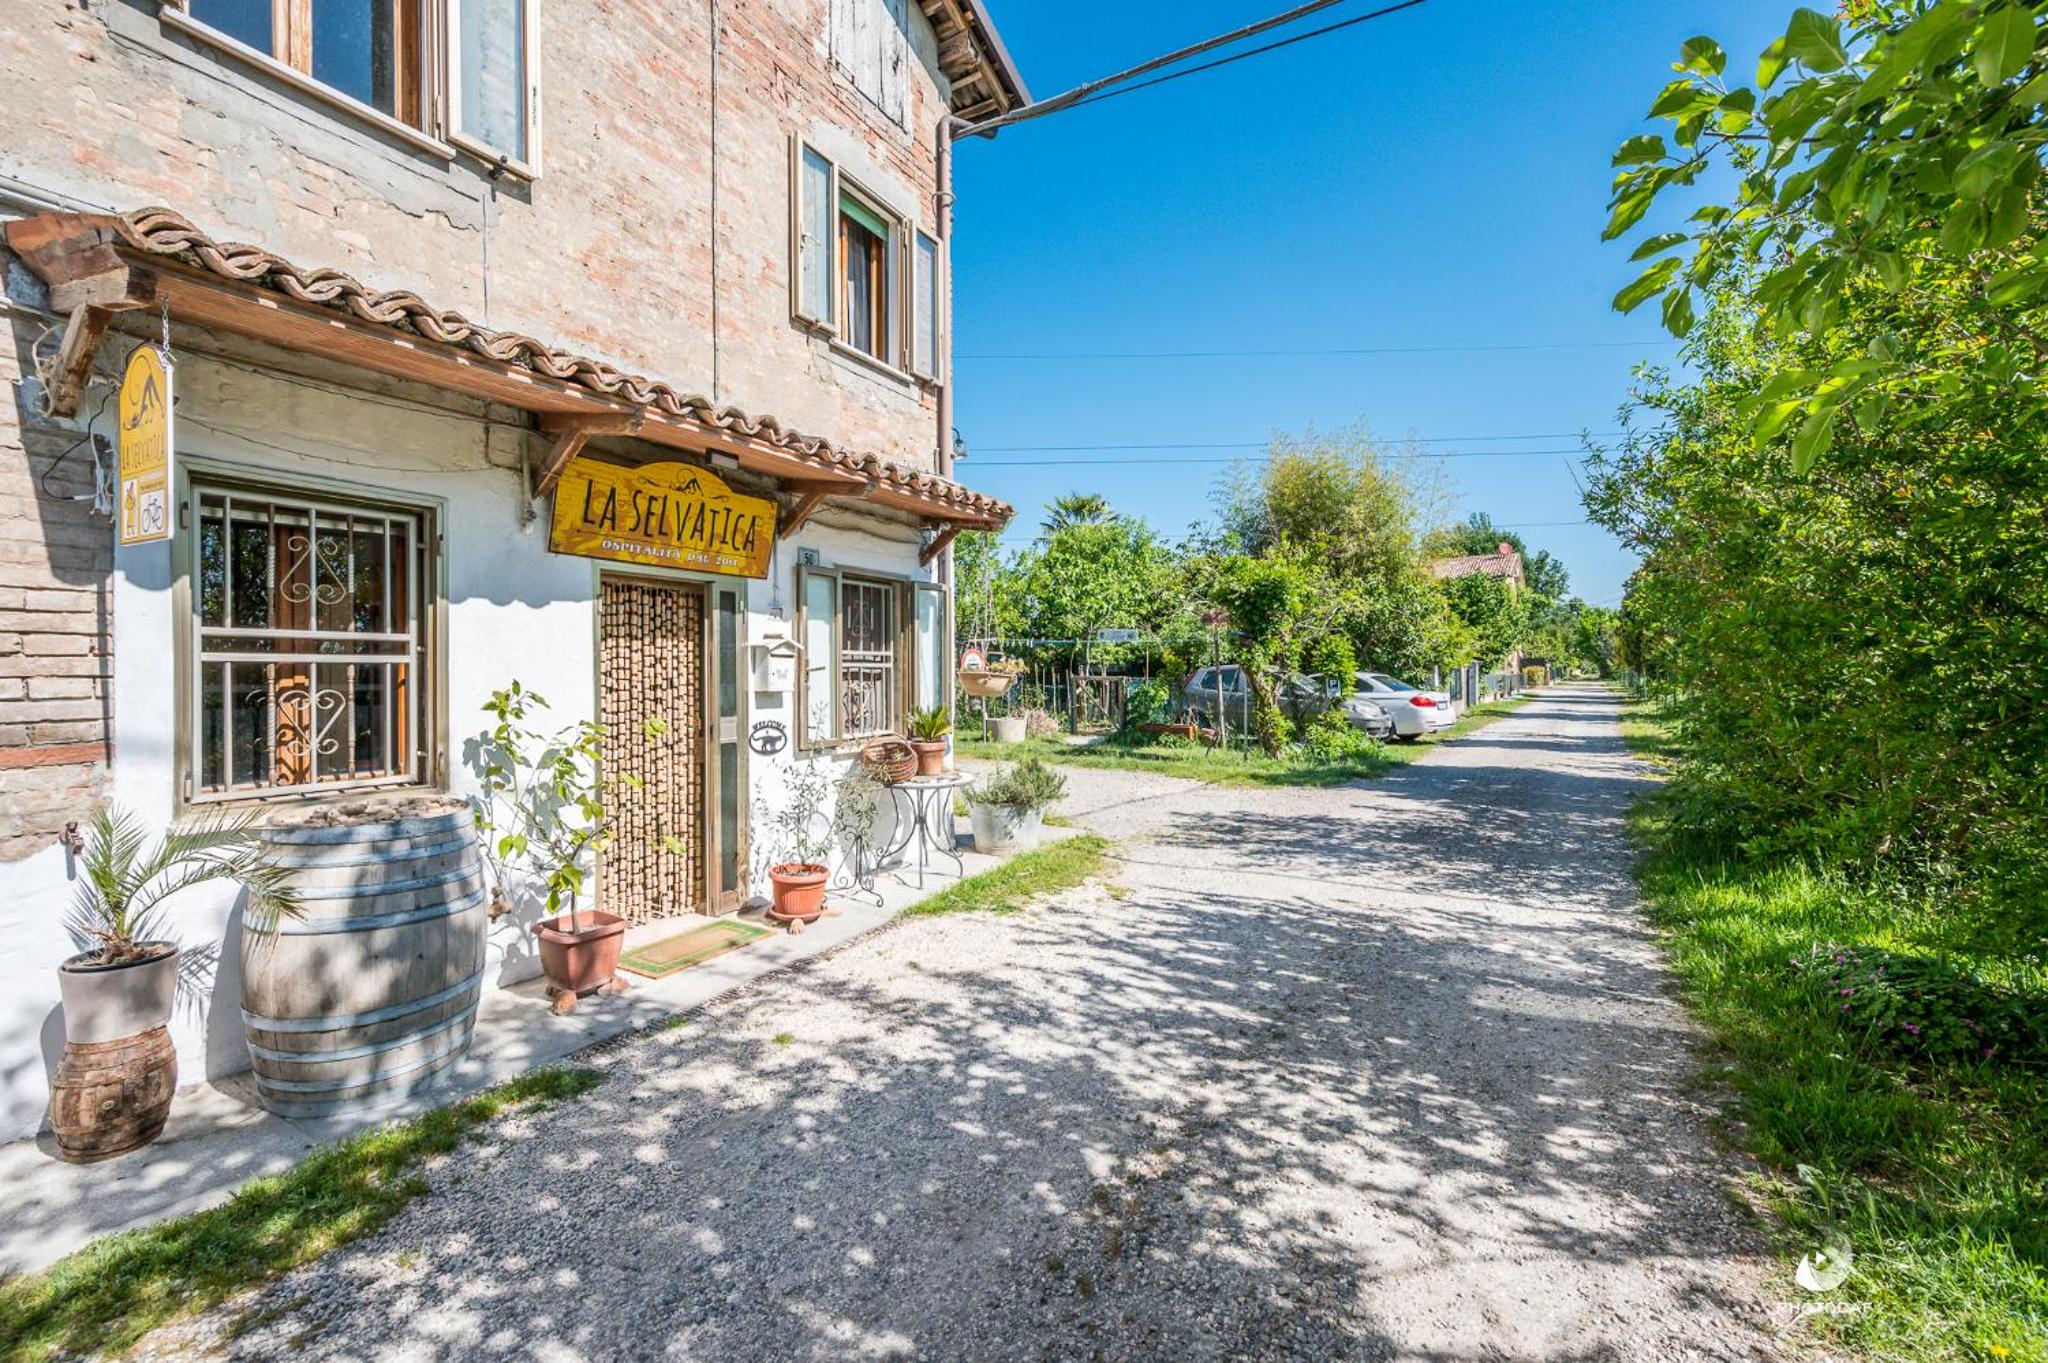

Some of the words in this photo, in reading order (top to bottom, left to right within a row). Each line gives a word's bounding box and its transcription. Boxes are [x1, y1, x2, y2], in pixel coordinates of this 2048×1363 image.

[582, 479, 617, 532] LA
[628, 489, 758, 552] SELVATICA
[688, 552, 709, 564] DAL
